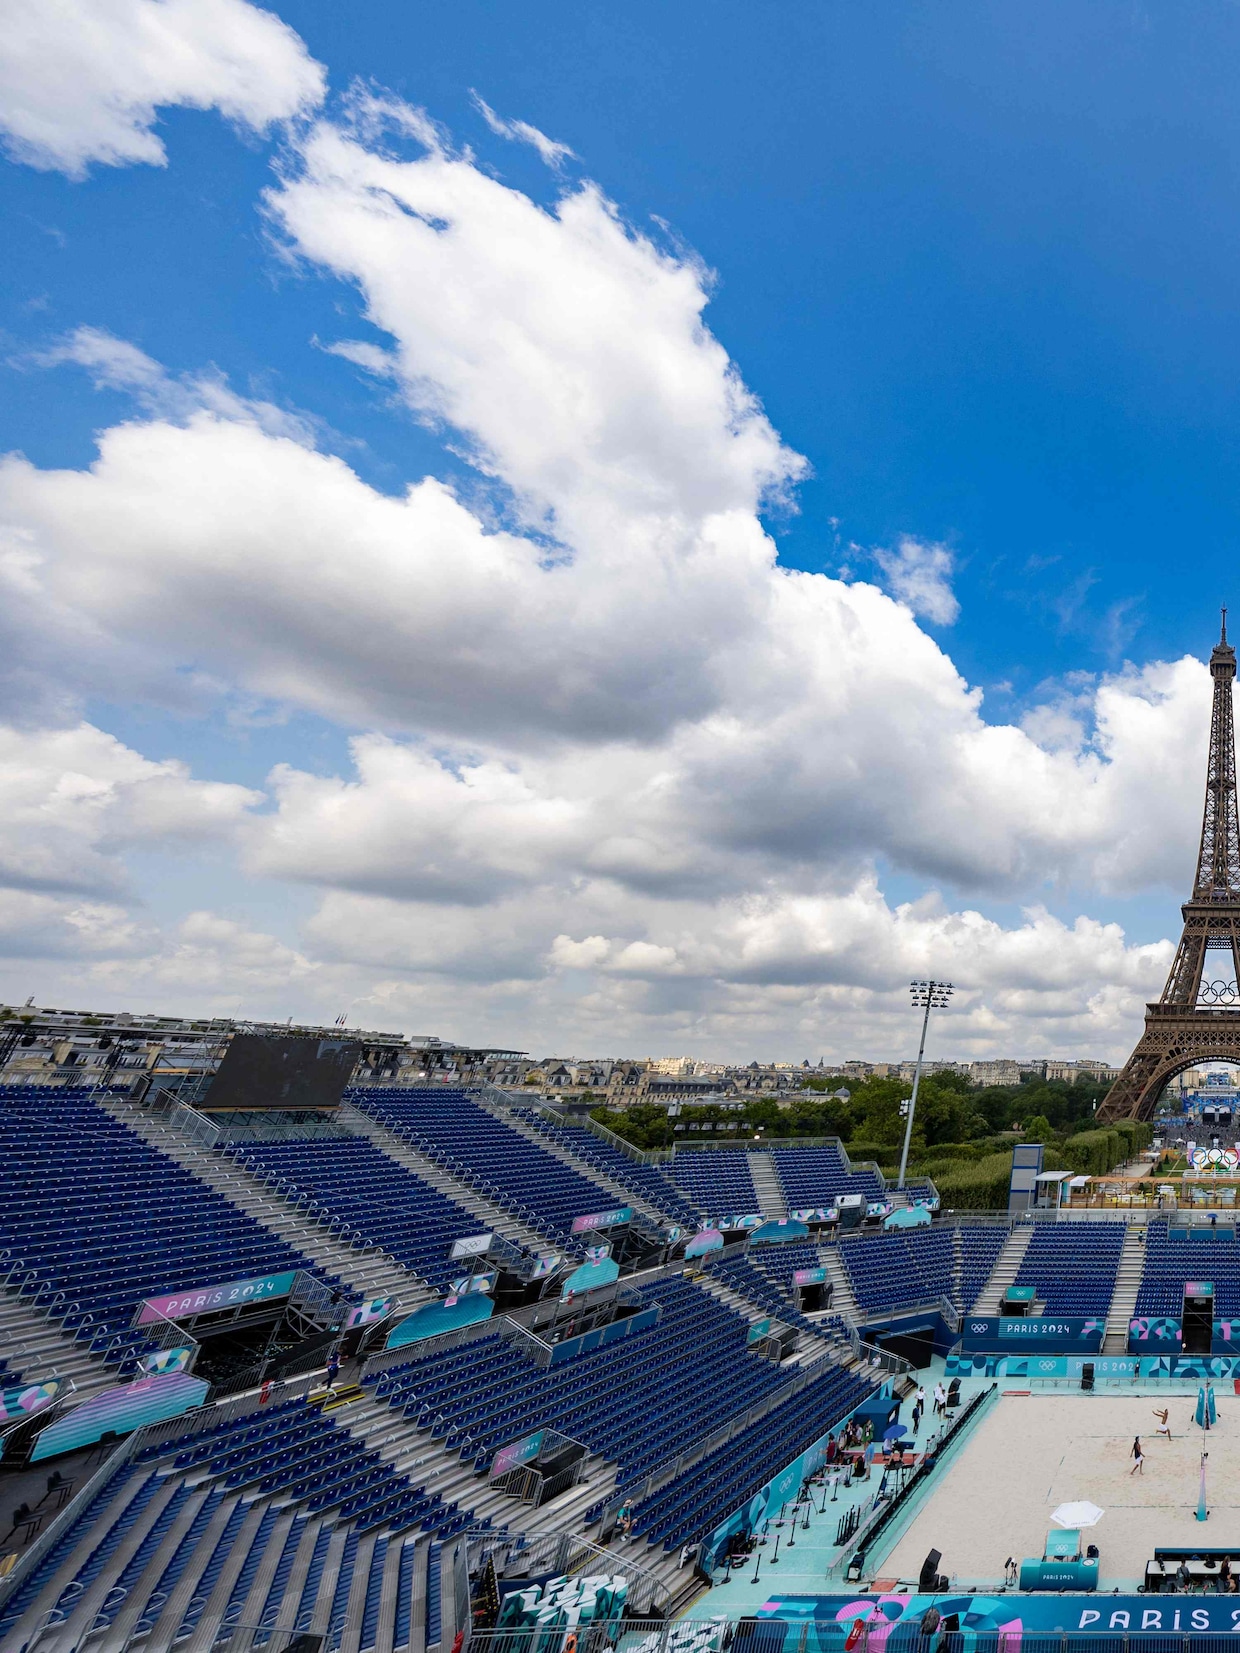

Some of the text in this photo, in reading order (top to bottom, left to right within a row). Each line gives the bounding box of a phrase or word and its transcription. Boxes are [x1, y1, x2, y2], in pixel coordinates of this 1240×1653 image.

[228, 1281, 275, 1300] 2024
[1041, 1324, 1070, 1333] 2024
[1076, 1362, 1134, 1371] PRIS 202
